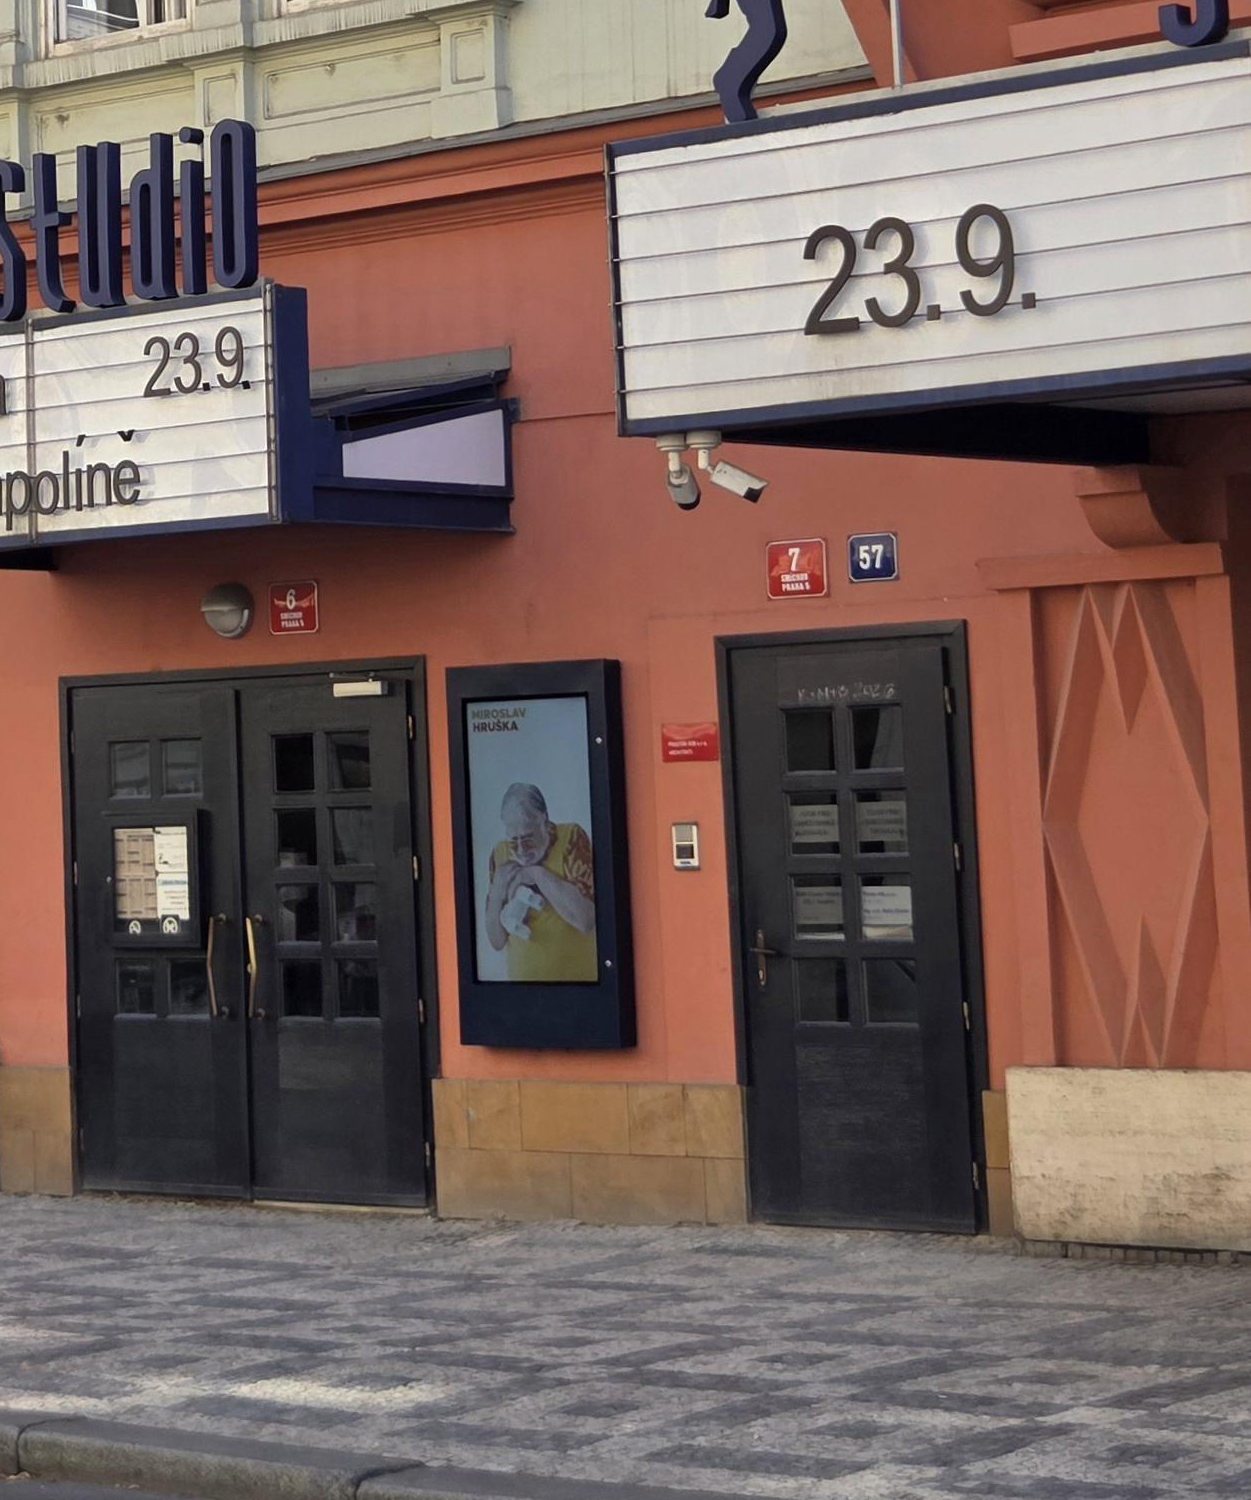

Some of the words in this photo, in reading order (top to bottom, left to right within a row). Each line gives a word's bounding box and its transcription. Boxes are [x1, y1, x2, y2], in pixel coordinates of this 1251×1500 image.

[802, 203, 1037, 336] 23.9.
[143, 326, 251, 398] 23.9.
[788, 547, 801, 572] 7
[859, 544, 884, 570] 57
[286, 588, 296, 610] 6
[471, 707, 527, 720] MIROSLAV
[473, 719, 518, 732] HRUŠKA
